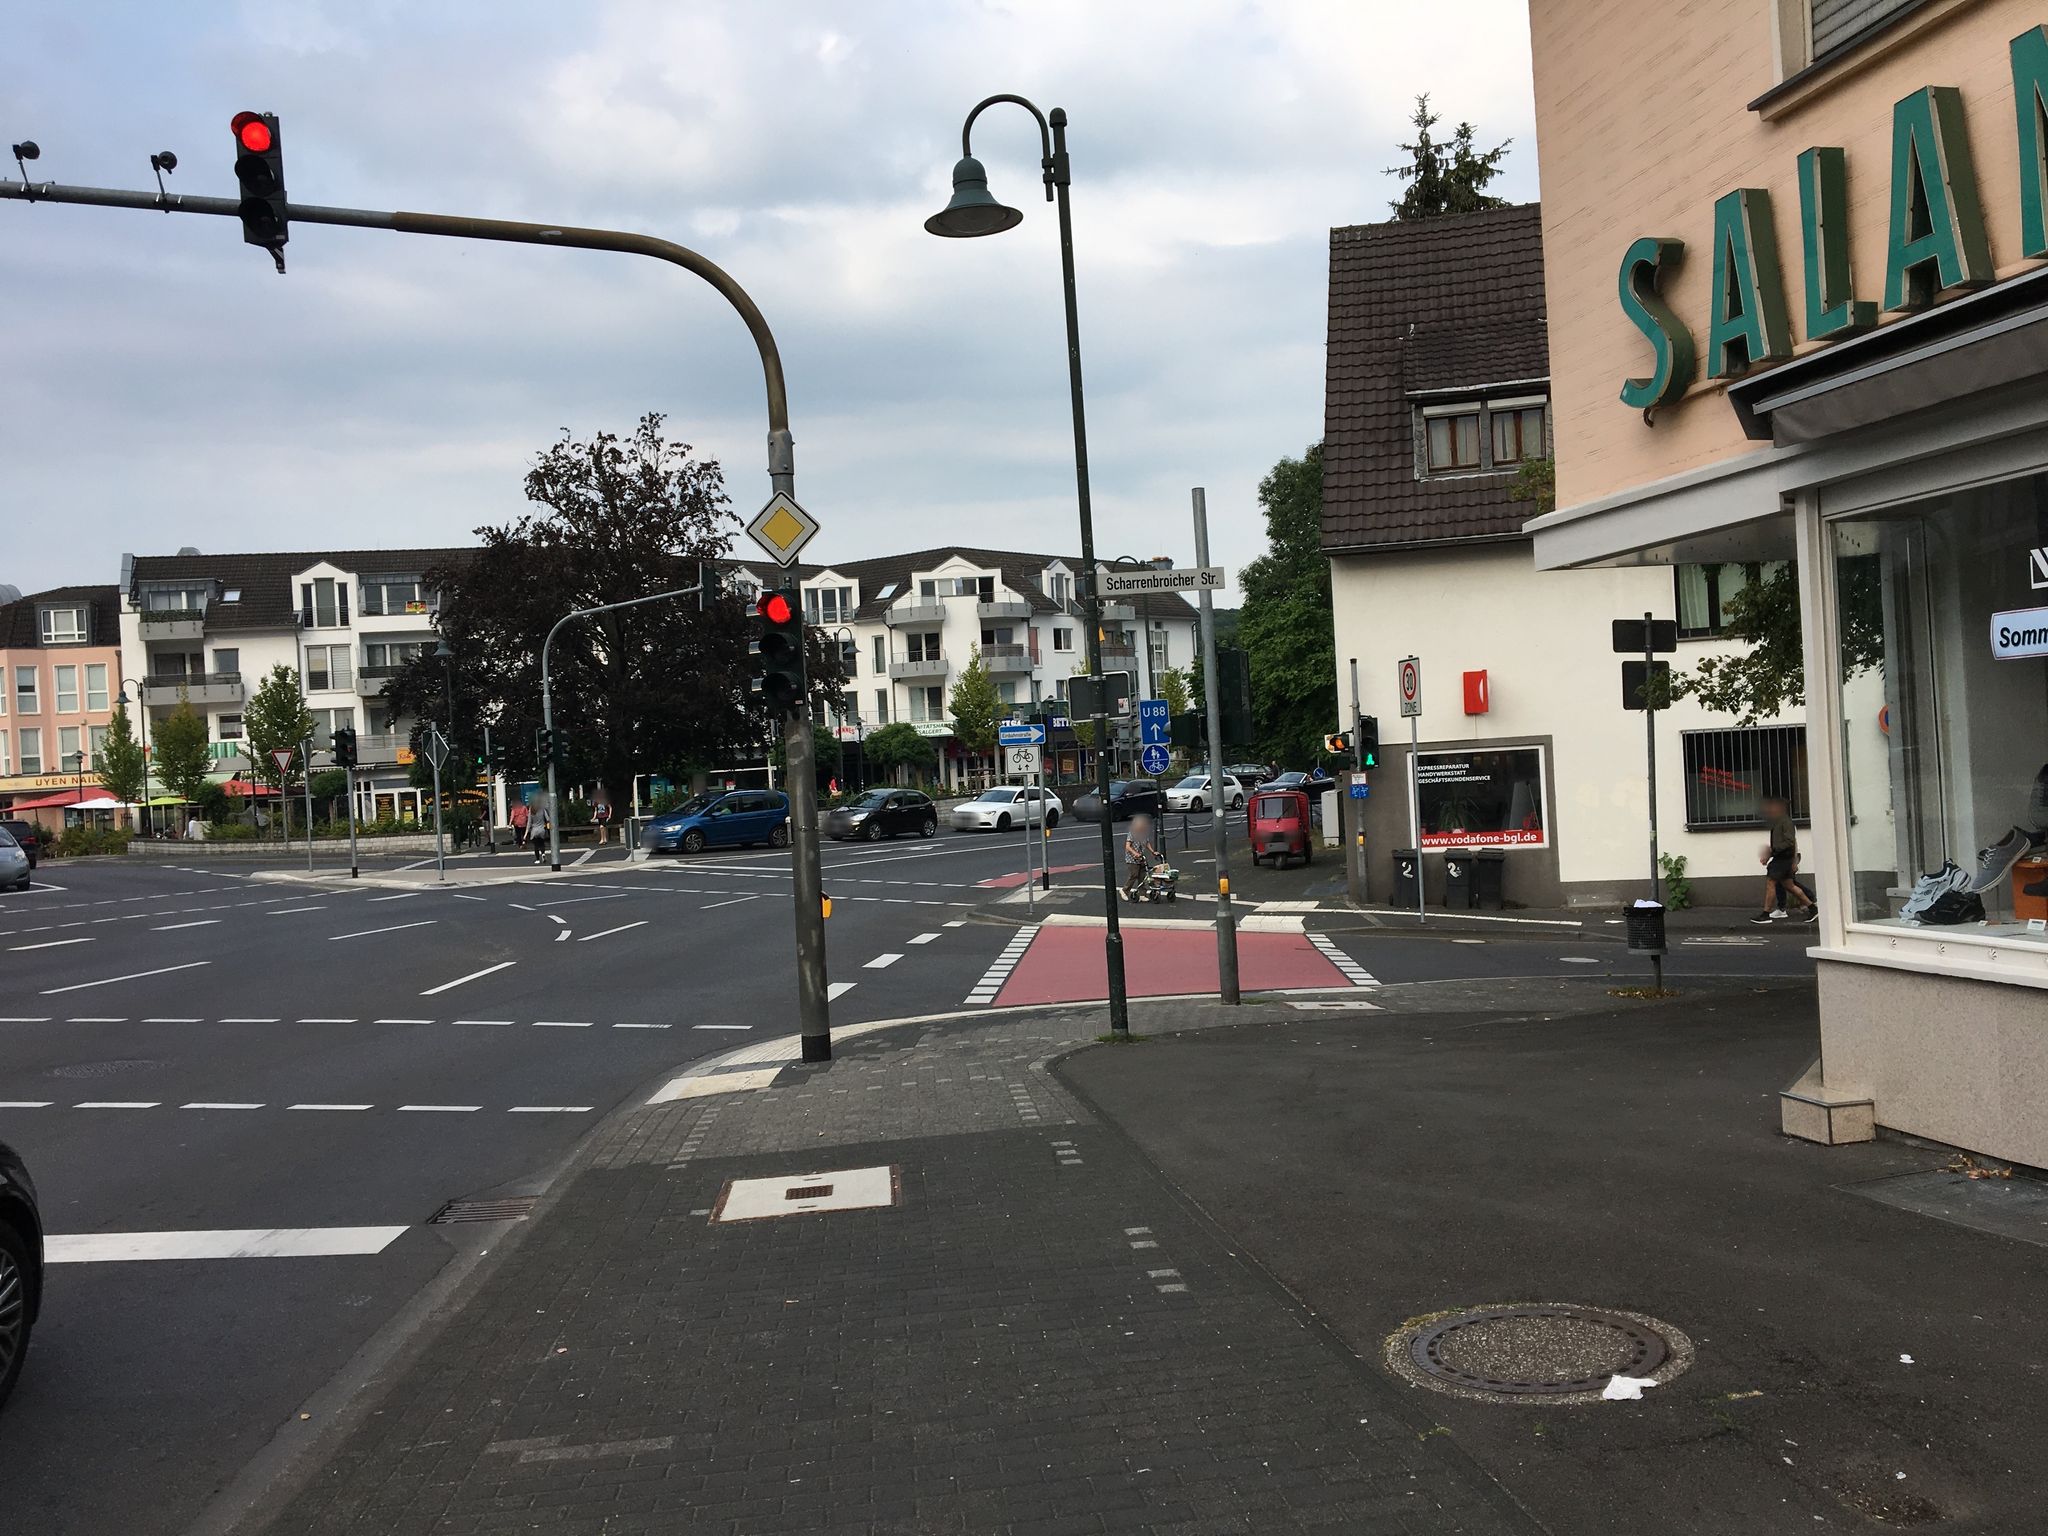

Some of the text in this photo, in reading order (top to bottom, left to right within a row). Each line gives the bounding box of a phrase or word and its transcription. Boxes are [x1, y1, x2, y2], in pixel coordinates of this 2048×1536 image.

[1106, 571, 1219, 590] Scharrenbroicher Str.
[1406, 672, 1414, 691] 30
[1142, 706, 1166, 717] U 88
[1405, 701, 1417, 713] ZONE
[1417, 763, 1470, 771] EXPRESSREPARATUR
[1417, 770, 1467, 778] HANDYWERKSTATT
[1418, 775, 1491, 784] GESCHÄFTSKUNDENSERVICE
[36, 777, 67, 786] UYEN
[1422, 832, 1537, 845] www.vodafone-bgl.de
